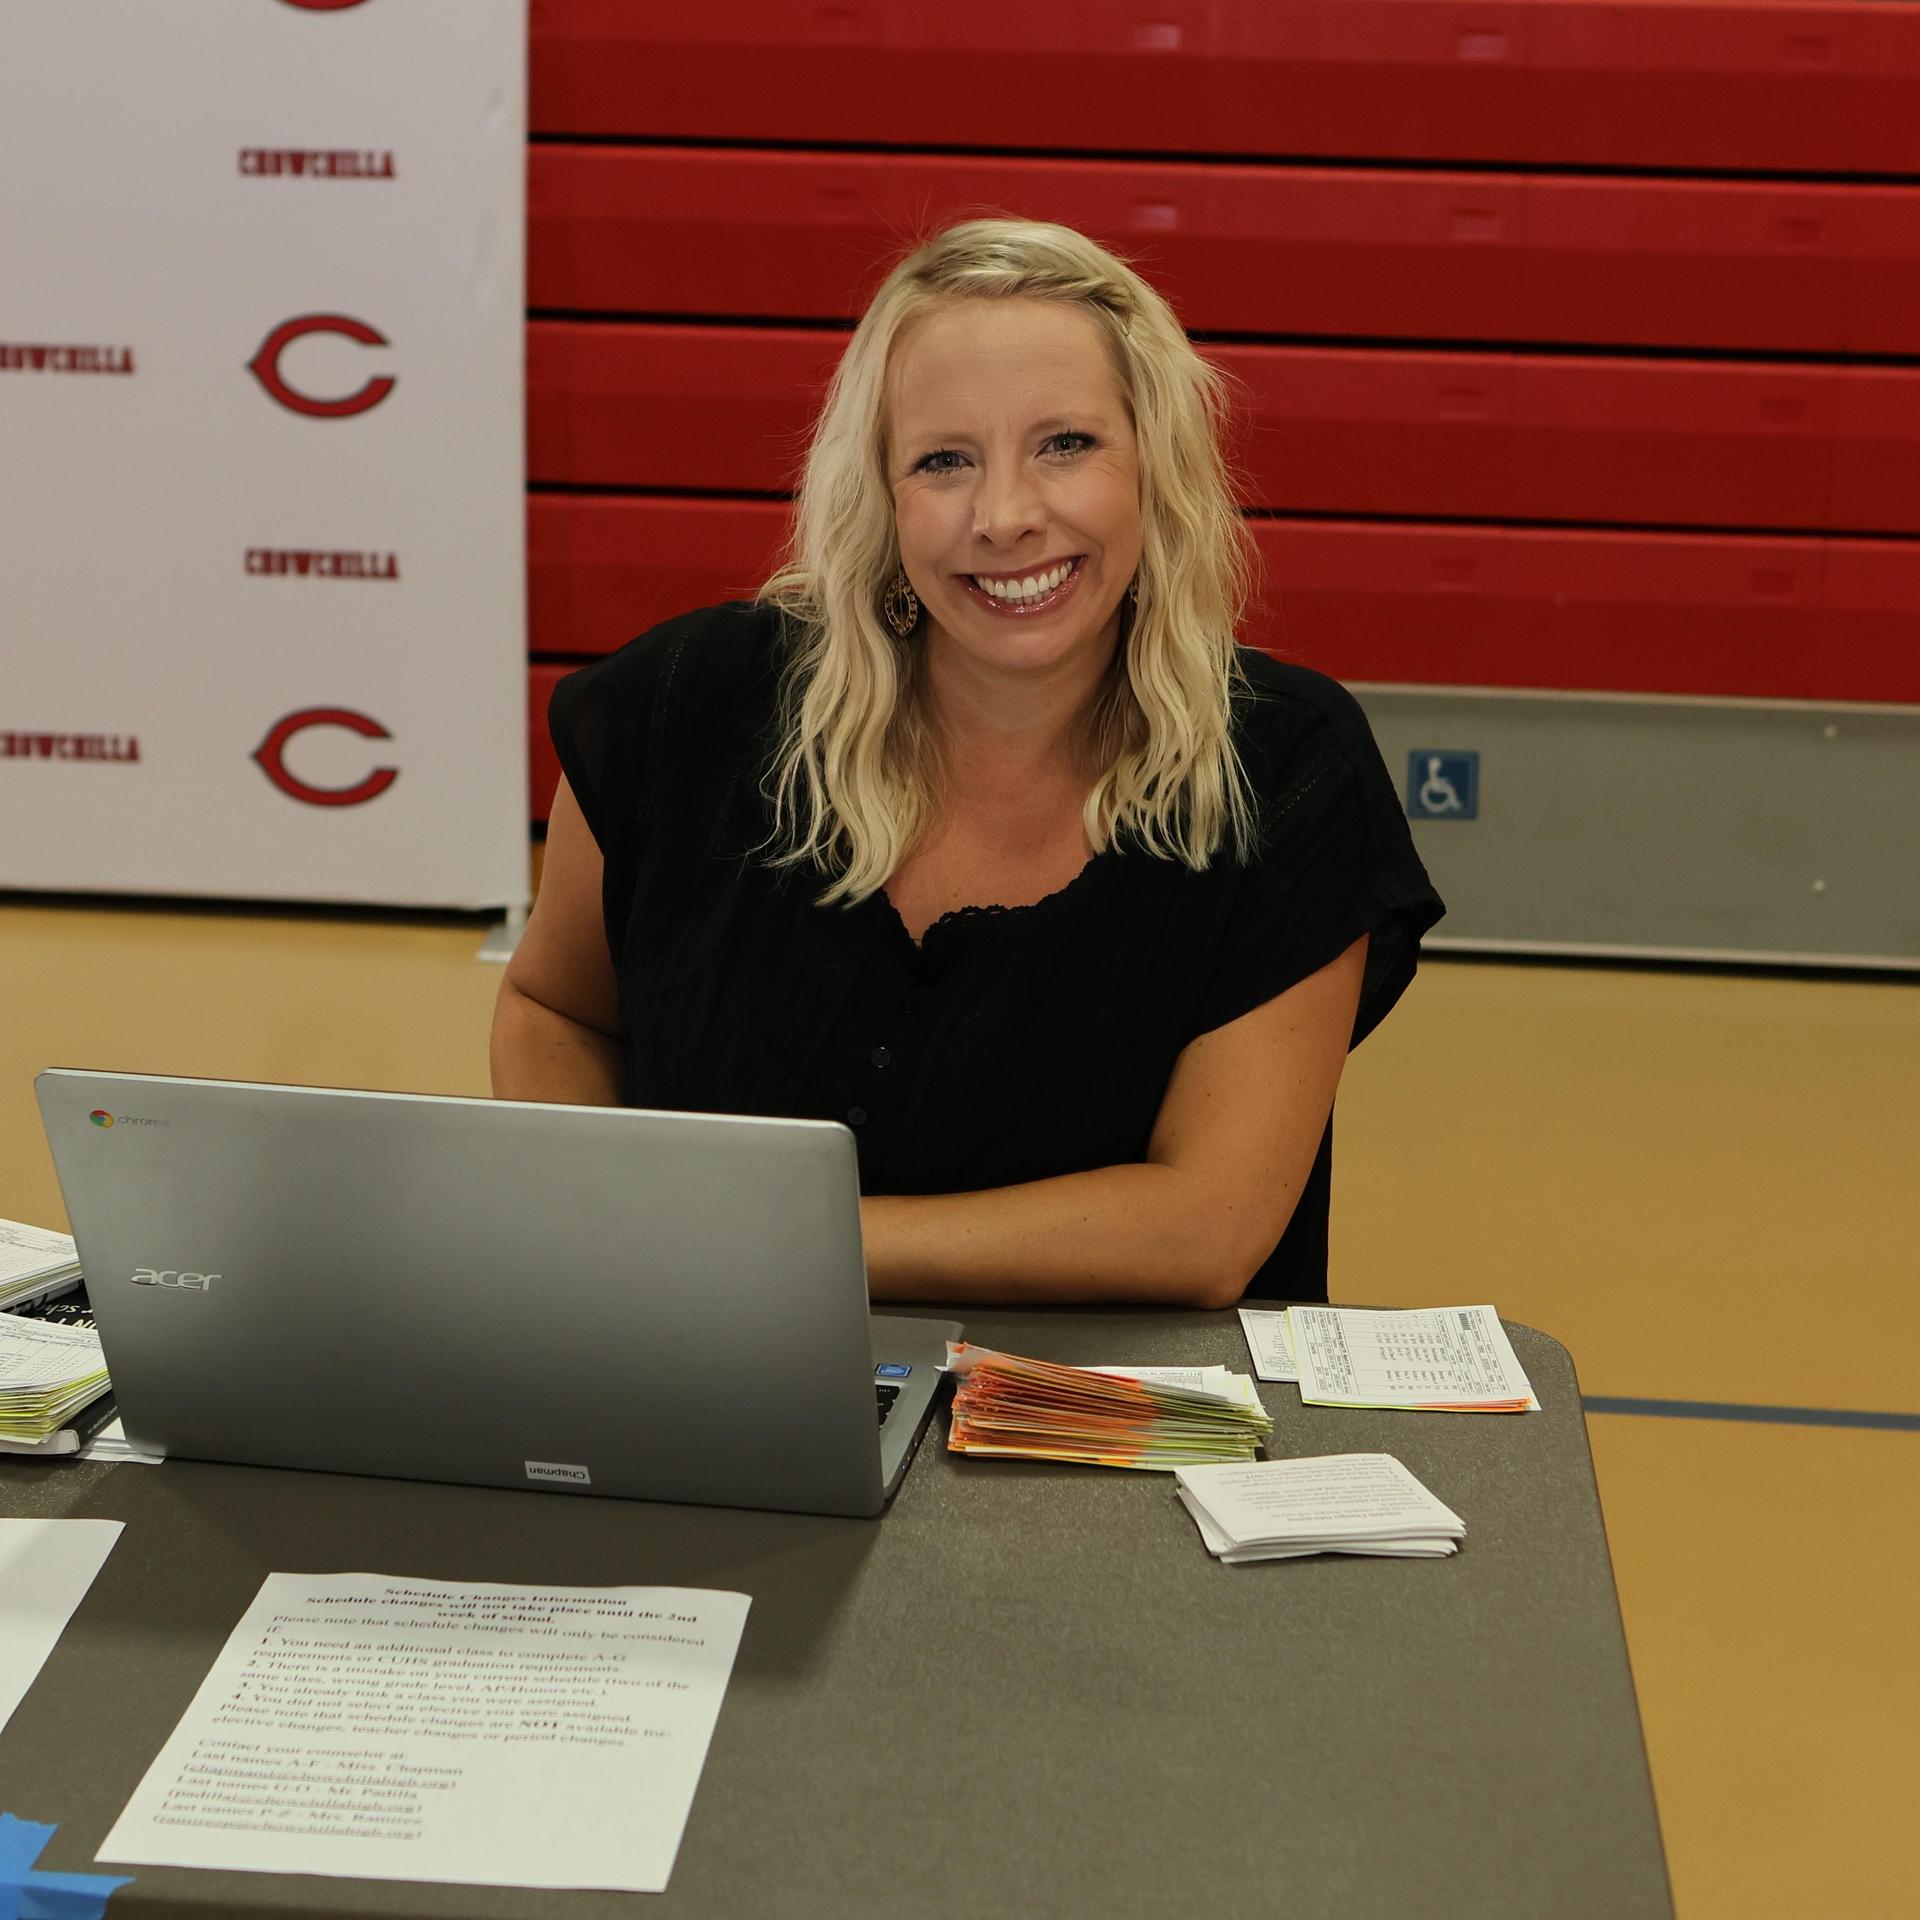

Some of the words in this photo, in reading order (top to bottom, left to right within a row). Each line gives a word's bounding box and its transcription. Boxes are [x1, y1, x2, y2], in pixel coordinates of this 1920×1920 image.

[239, 149, 396, 179] CHOWCHILLA
[0, 344, 134, 375] HOWCHILLA
[245, 547, 400, 581] CHOWCHILLA
[0, 732, 140, 763] HOWCHILLA
[118, 1113, 170, 1127] chrome
[130, 1268, 223, 1290] acer
[529, 1467, 586, 1480] Chapman
[381, 1598, 442, 1607] changes
[549, 1605, 590, 1614] place
[596, 1609, 633, 1617] until
[669, 1613, 697, 1622] 2nd
[386, 1588, 454, 1600] Schedule
[532, 1596, 626, 1605] Information
[272, 1615, 319, 1623] Please
[361, 1617, 388, 1625] that
[394, 1619, 458, 1629] schedule
[463, 1622, 523, 1633] changes
[529, 1627, 557, 1635] will
[562, 1630, 592, 1638] only
[623, 1634, 704, 1646] considered
